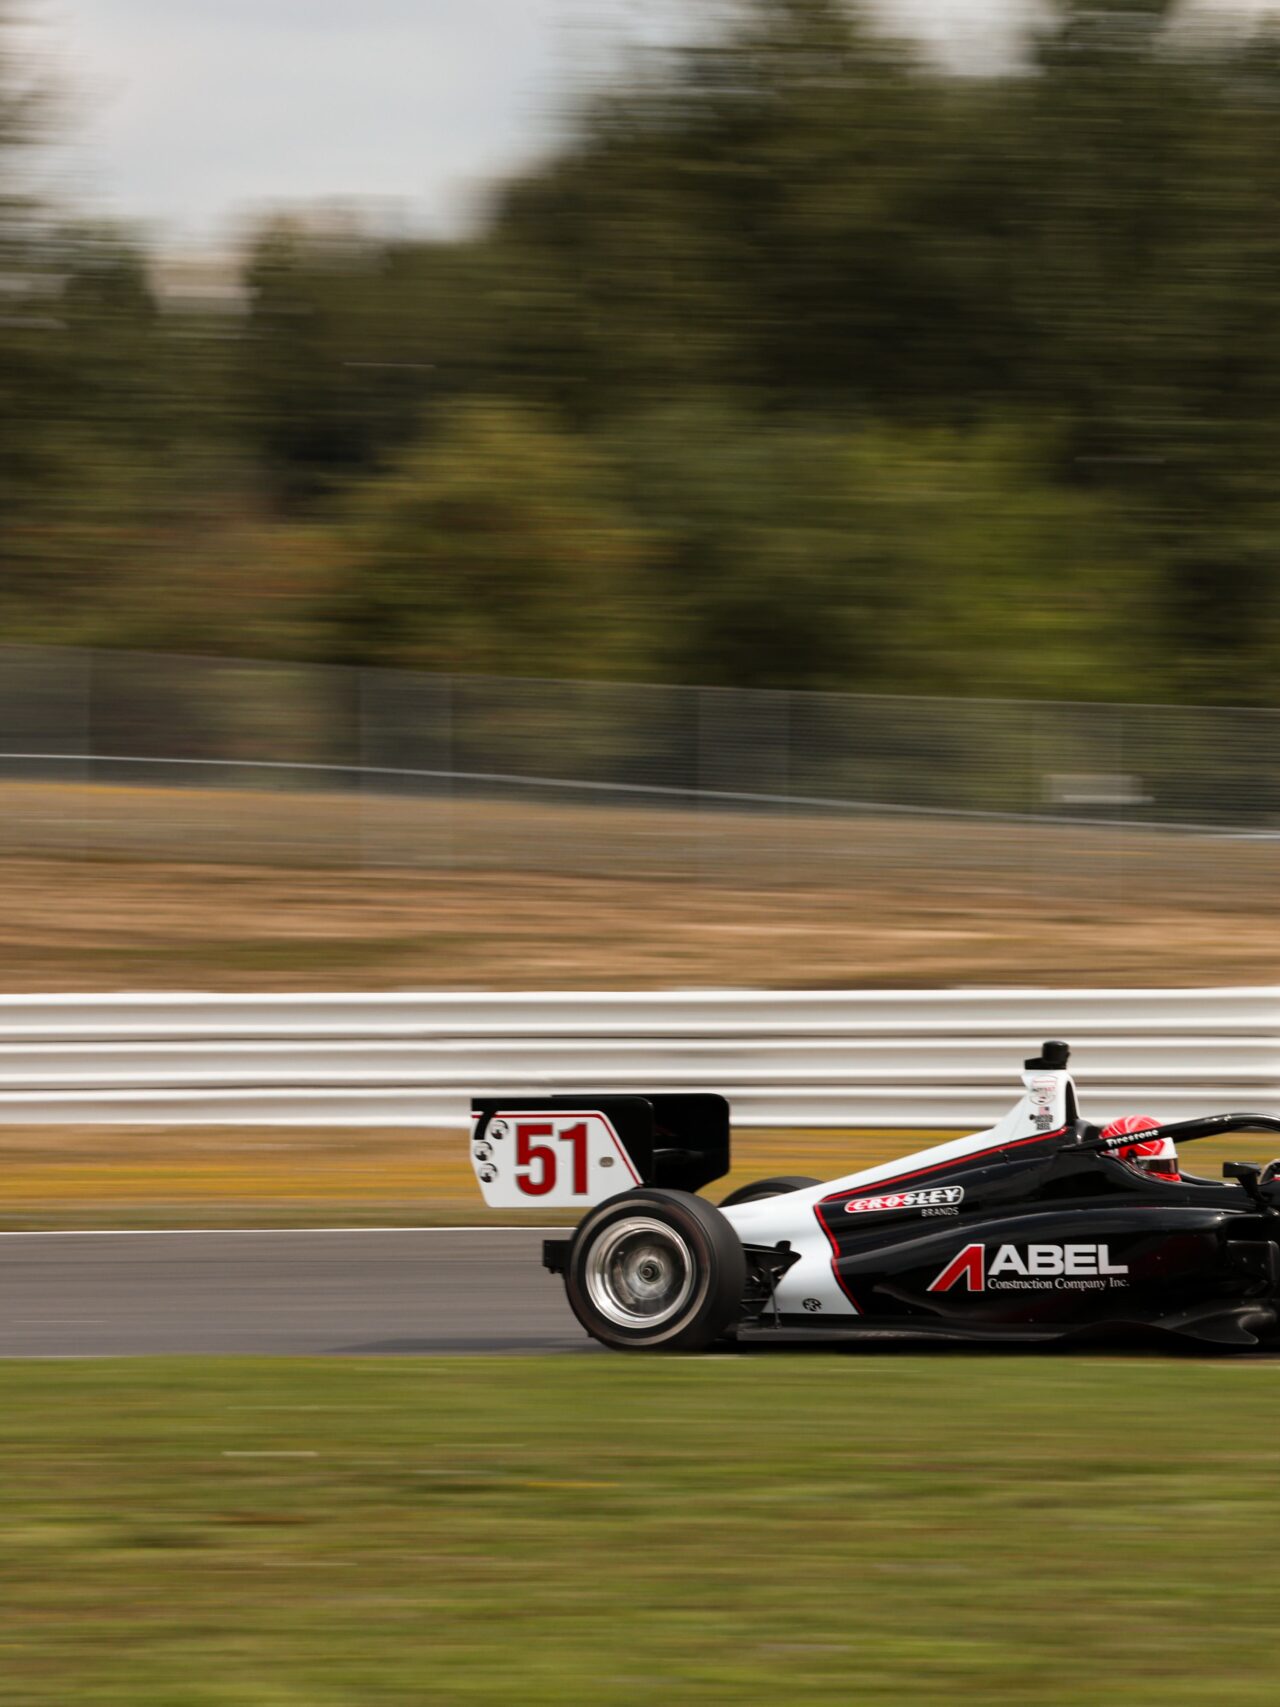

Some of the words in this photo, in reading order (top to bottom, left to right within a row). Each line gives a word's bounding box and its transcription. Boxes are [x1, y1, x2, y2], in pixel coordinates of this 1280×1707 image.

[1106, 1129, 1158, 1147] Firestone
[515, 1122, 589, 1197] 51
[852, 1188, 961, 1211] CROSLEY
[921, 1206, 960, 1217] BRANDS
[988, 1244, 1129, 1276] ABEL
[988, 1276, 1054, 1290] Construction
[1055, 1276, 1106, 1292] Company
[1109, 1276, 1131, 1288] Inc.
